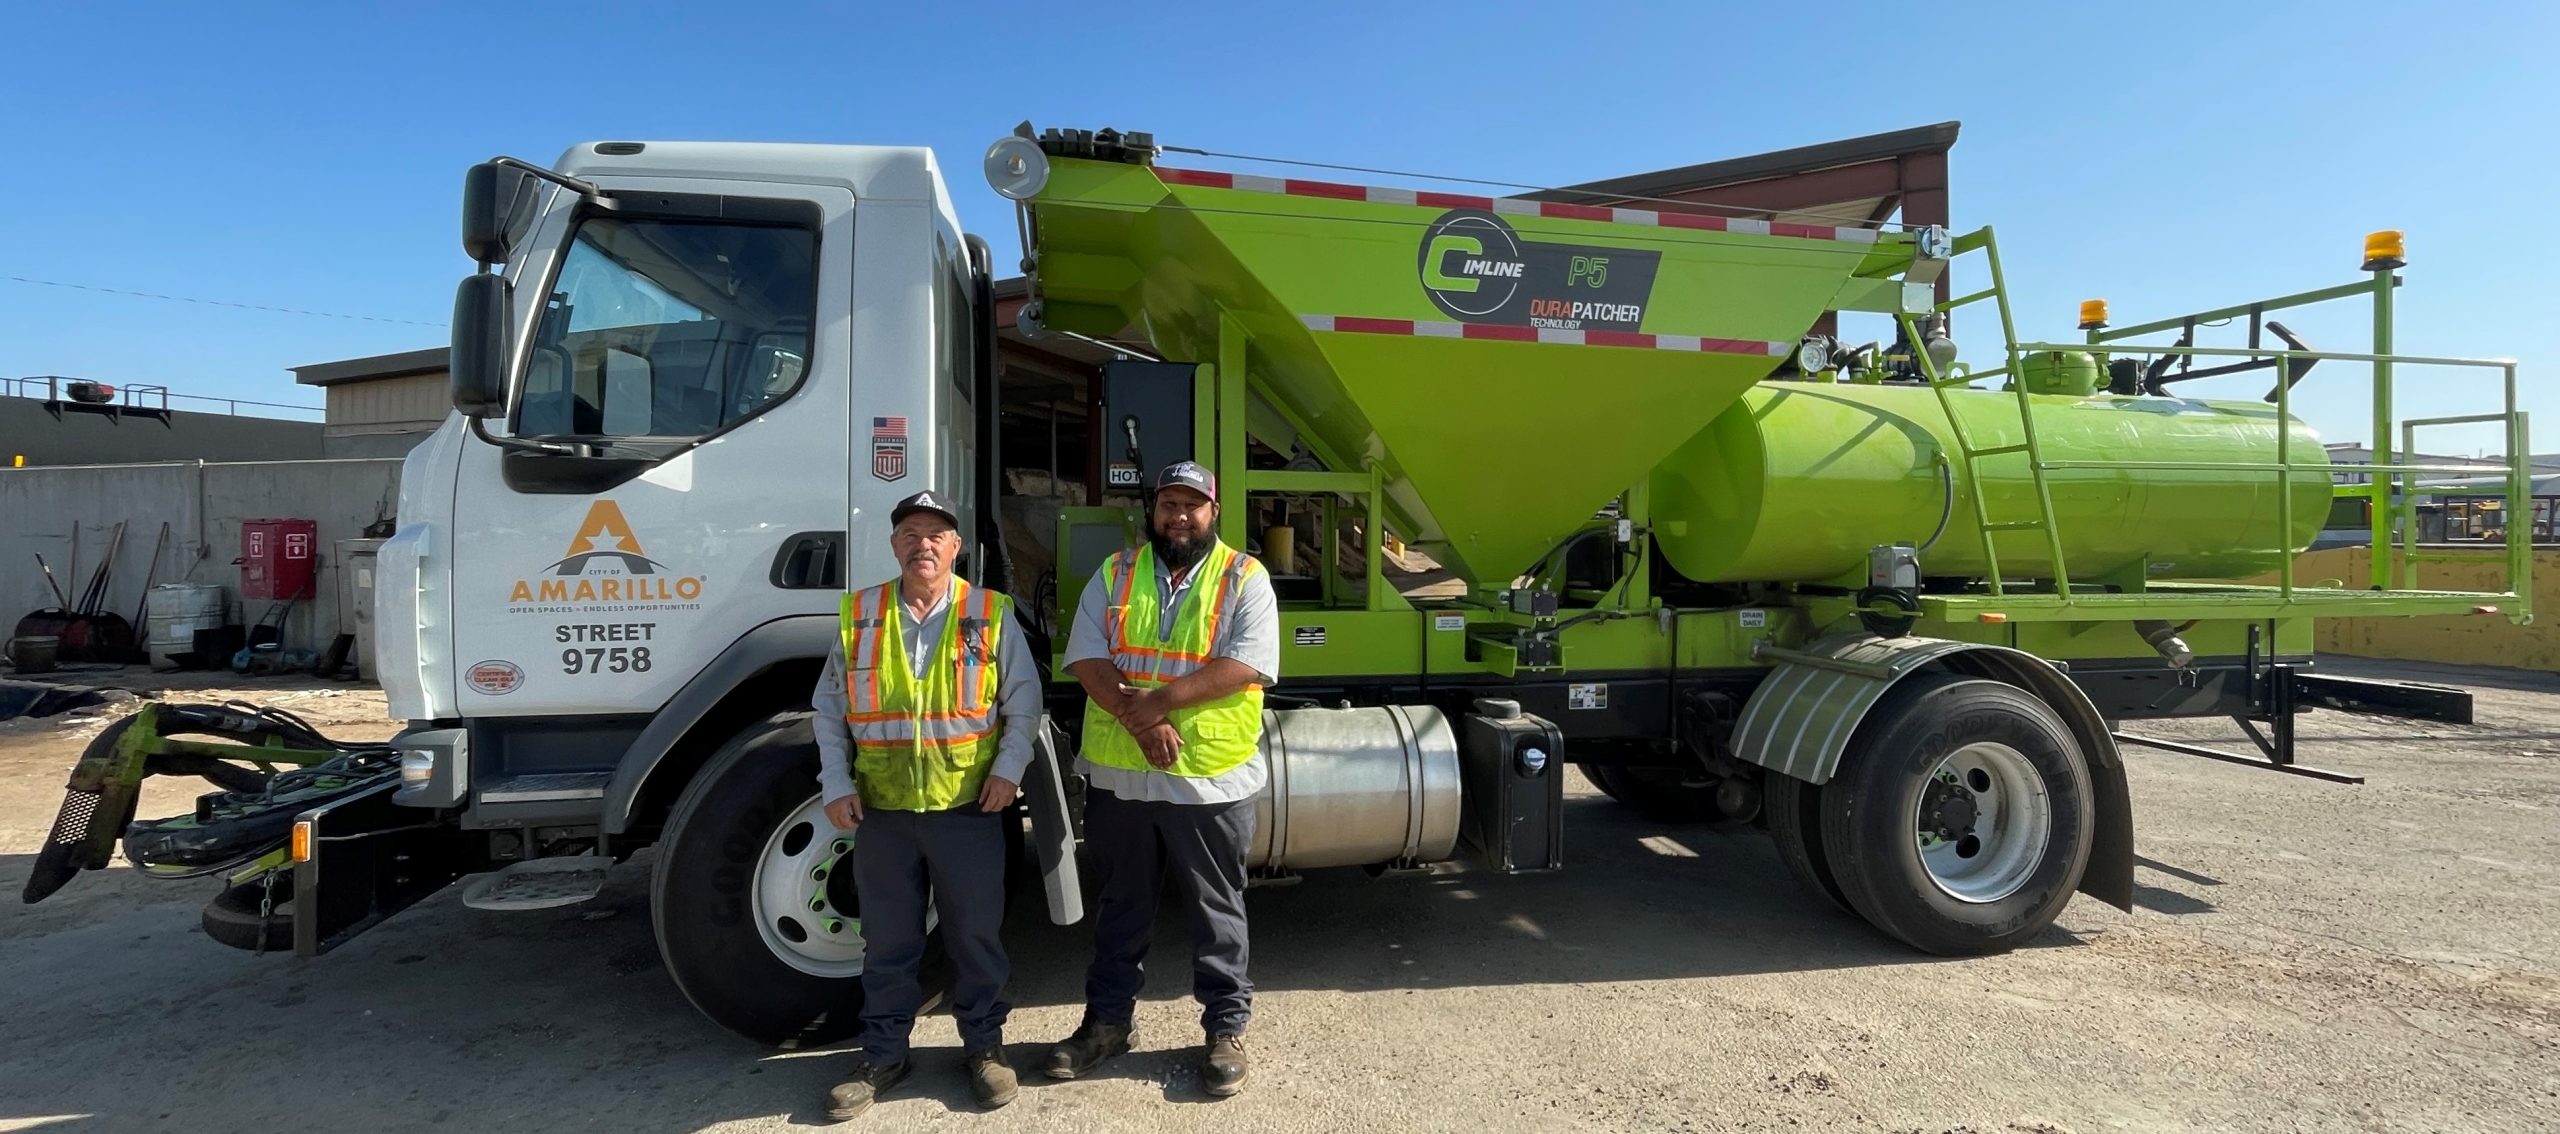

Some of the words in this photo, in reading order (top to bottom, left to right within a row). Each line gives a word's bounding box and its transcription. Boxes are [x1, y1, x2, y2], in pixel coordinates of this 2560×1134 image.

[1422, 234, 1525, 292] CIMLINE
[1567, 255, 1609, 288] P5
[1529, 299, 1640, 323] DURAPATCHER
[1530, 317, 1581, 330] TECHNOLOGY
[509, 576, 701, 602] AMARILLO
[509, 606, 535, 614] OPEN
[537, 606, 573, 614] SPACES
[627, 603, 701, 612] OPPORTUNITIES
[555, 623, 656, 643] STREET
[562, 647, 652, 674] 9758
